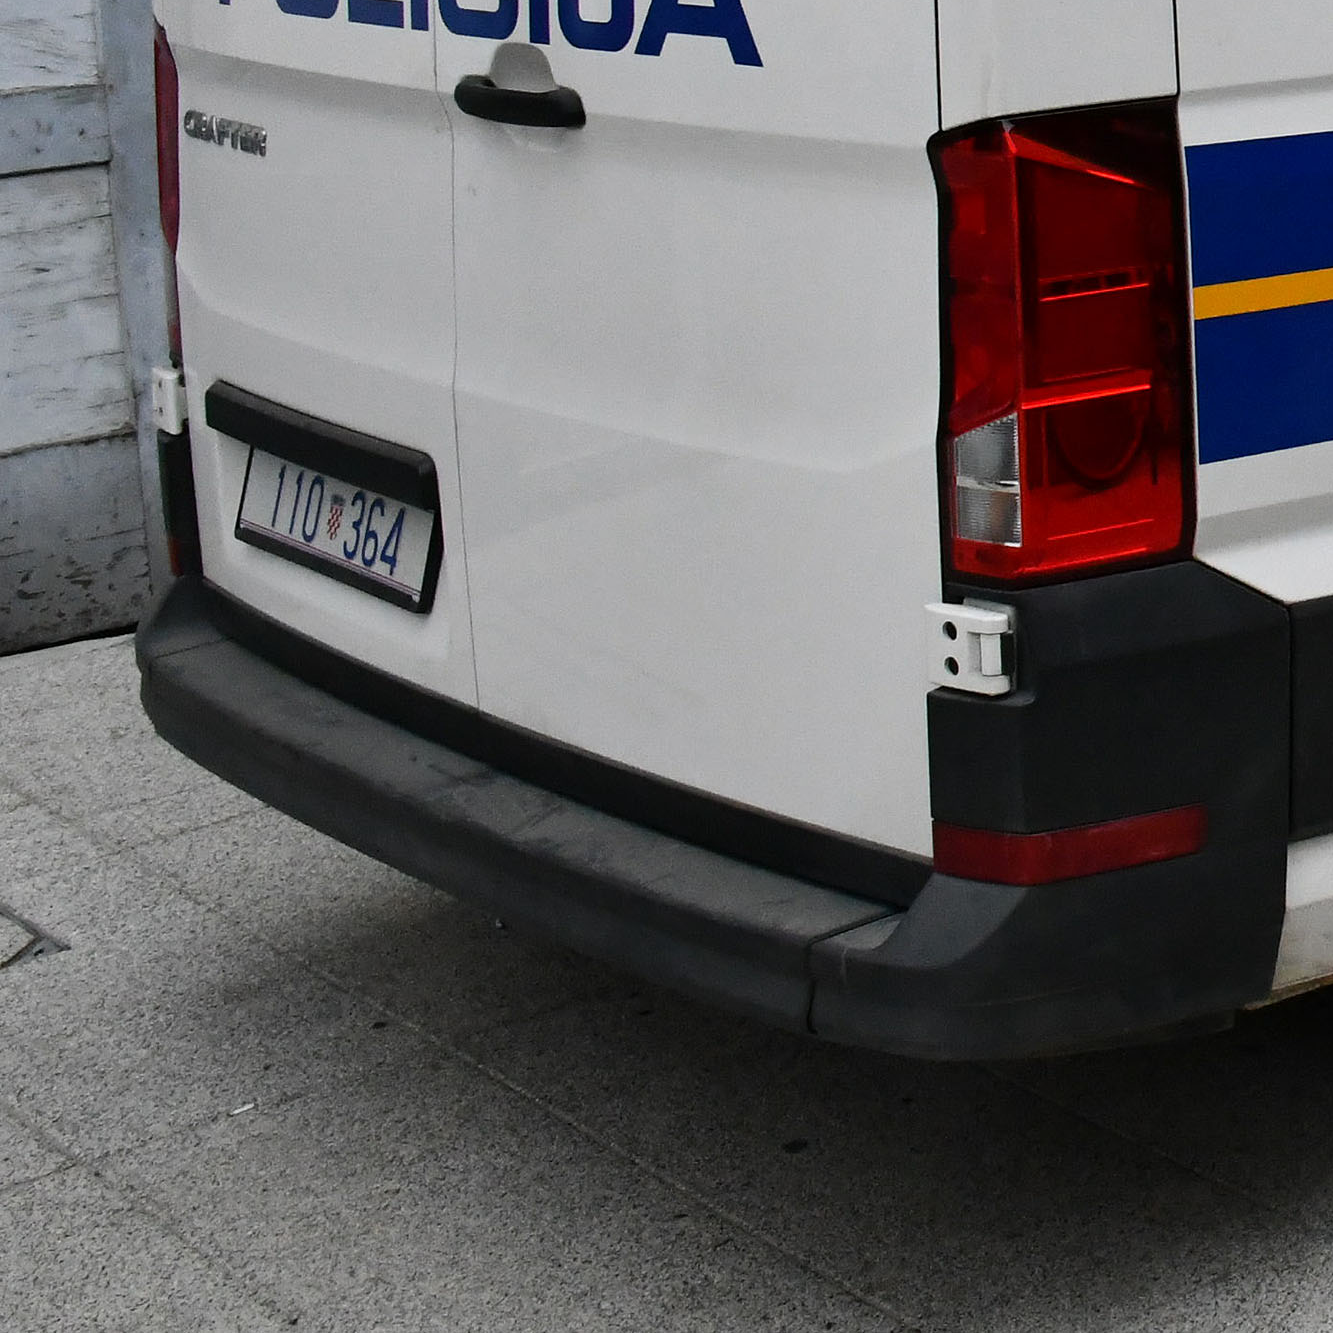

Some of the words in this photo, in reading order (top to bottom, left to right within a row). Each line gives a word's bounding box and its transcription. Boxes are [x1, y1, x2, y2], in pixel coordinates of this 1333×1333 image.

[183, 109, 268, 158] CRAFTER
[271, 464, 325, 544] 110
[343, 489, 407, 577] 364
